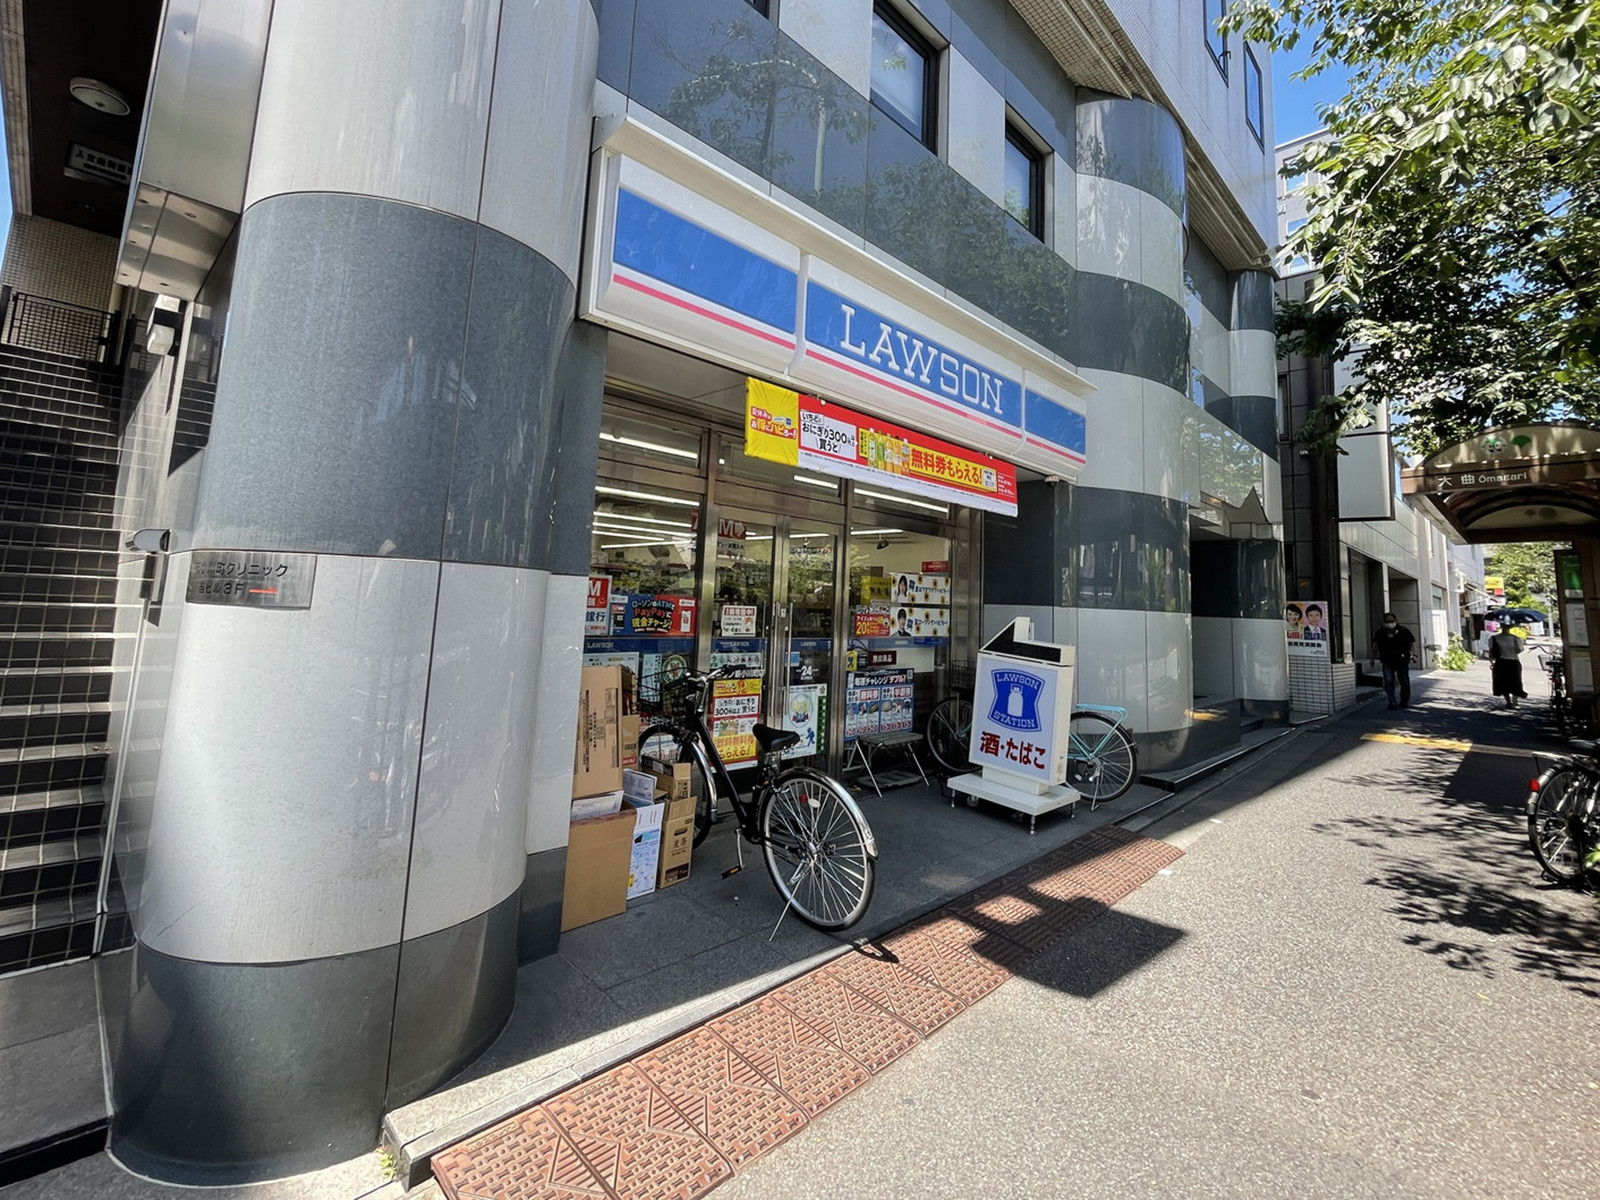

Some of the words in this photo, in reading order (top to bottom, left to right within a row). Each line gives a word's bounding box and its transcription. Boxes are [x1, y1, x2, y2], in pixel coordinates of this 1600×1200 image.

[841, 304, 1003, 414] LAWSON
[911, 448, 983, 485] 無料券もらえる!
[801, 665, 812, 676] 24
[996, 673, 1040, 690] LAWSON
[993, 710, 1036, 728] STATION
[979, 730, 1046, 769] 酒・たばこ
